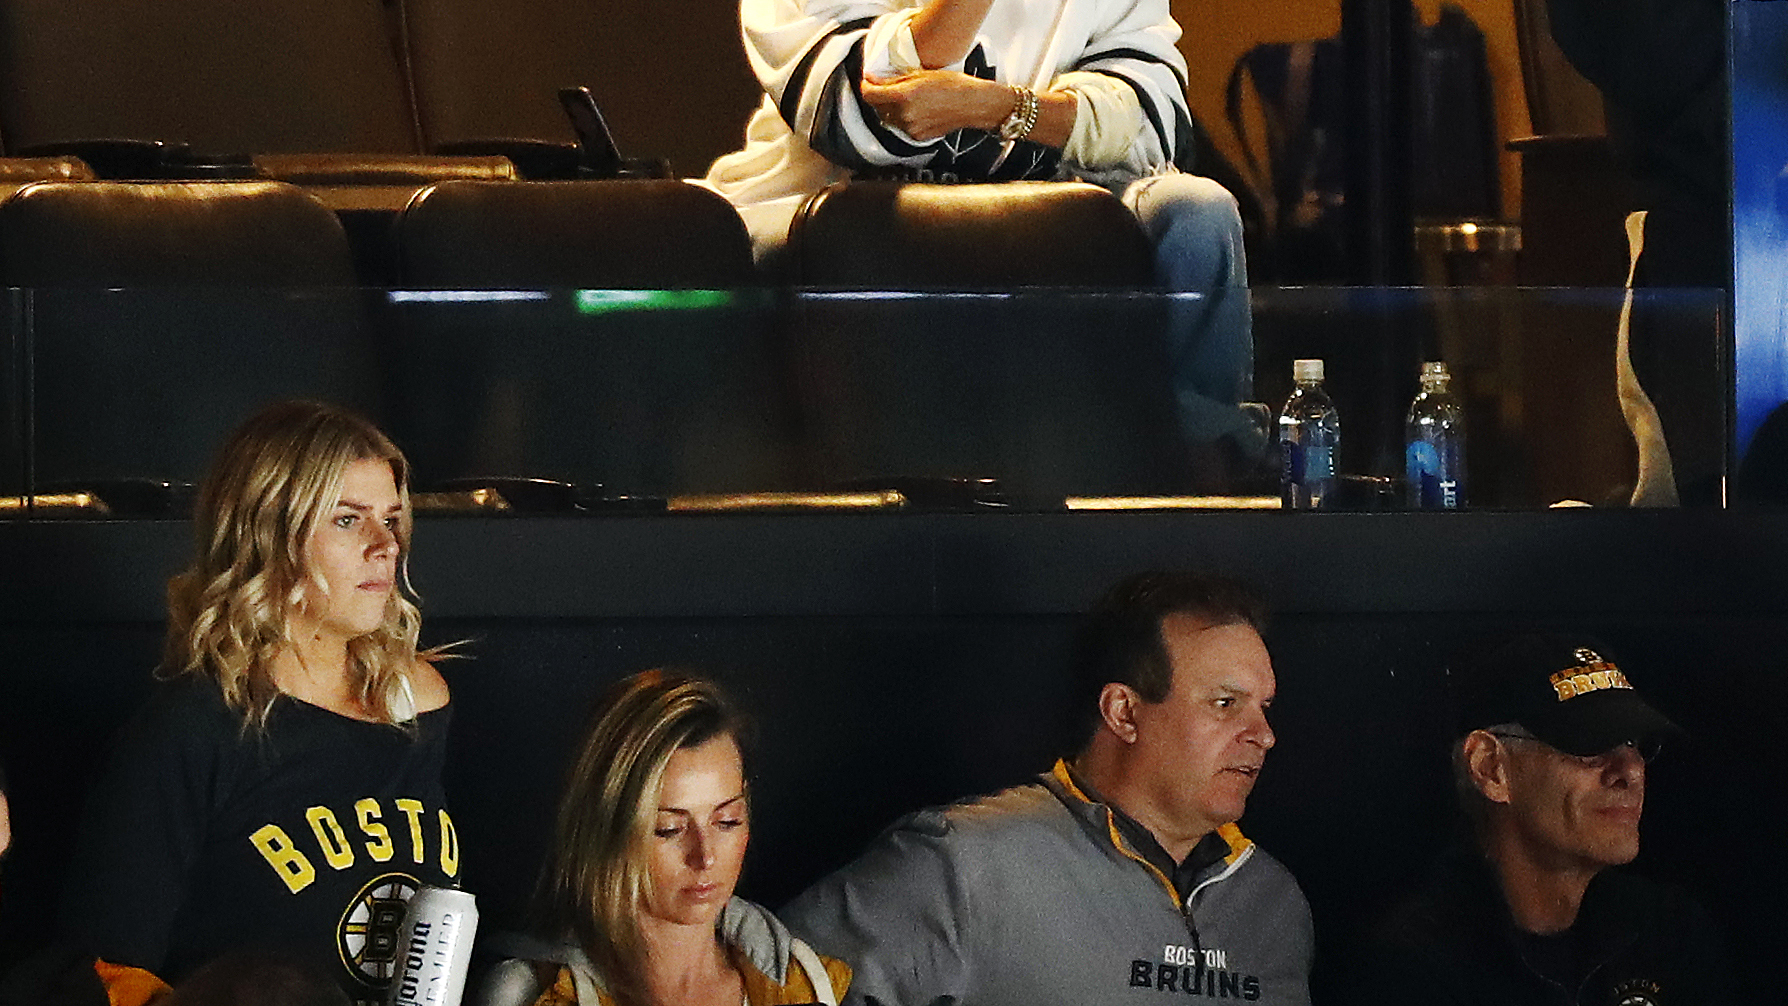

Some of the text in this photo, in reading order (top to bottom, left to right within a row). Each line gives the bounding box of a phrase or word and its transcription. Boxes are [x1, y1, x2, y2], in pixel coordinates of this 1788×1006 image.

[1439, 480, 1457, 508] art
[248, 797, 459, 895] BOSTO
[1163, 944, 1227, 969] BOSON
[1129, 959, 1261, 1002] BRUINS
